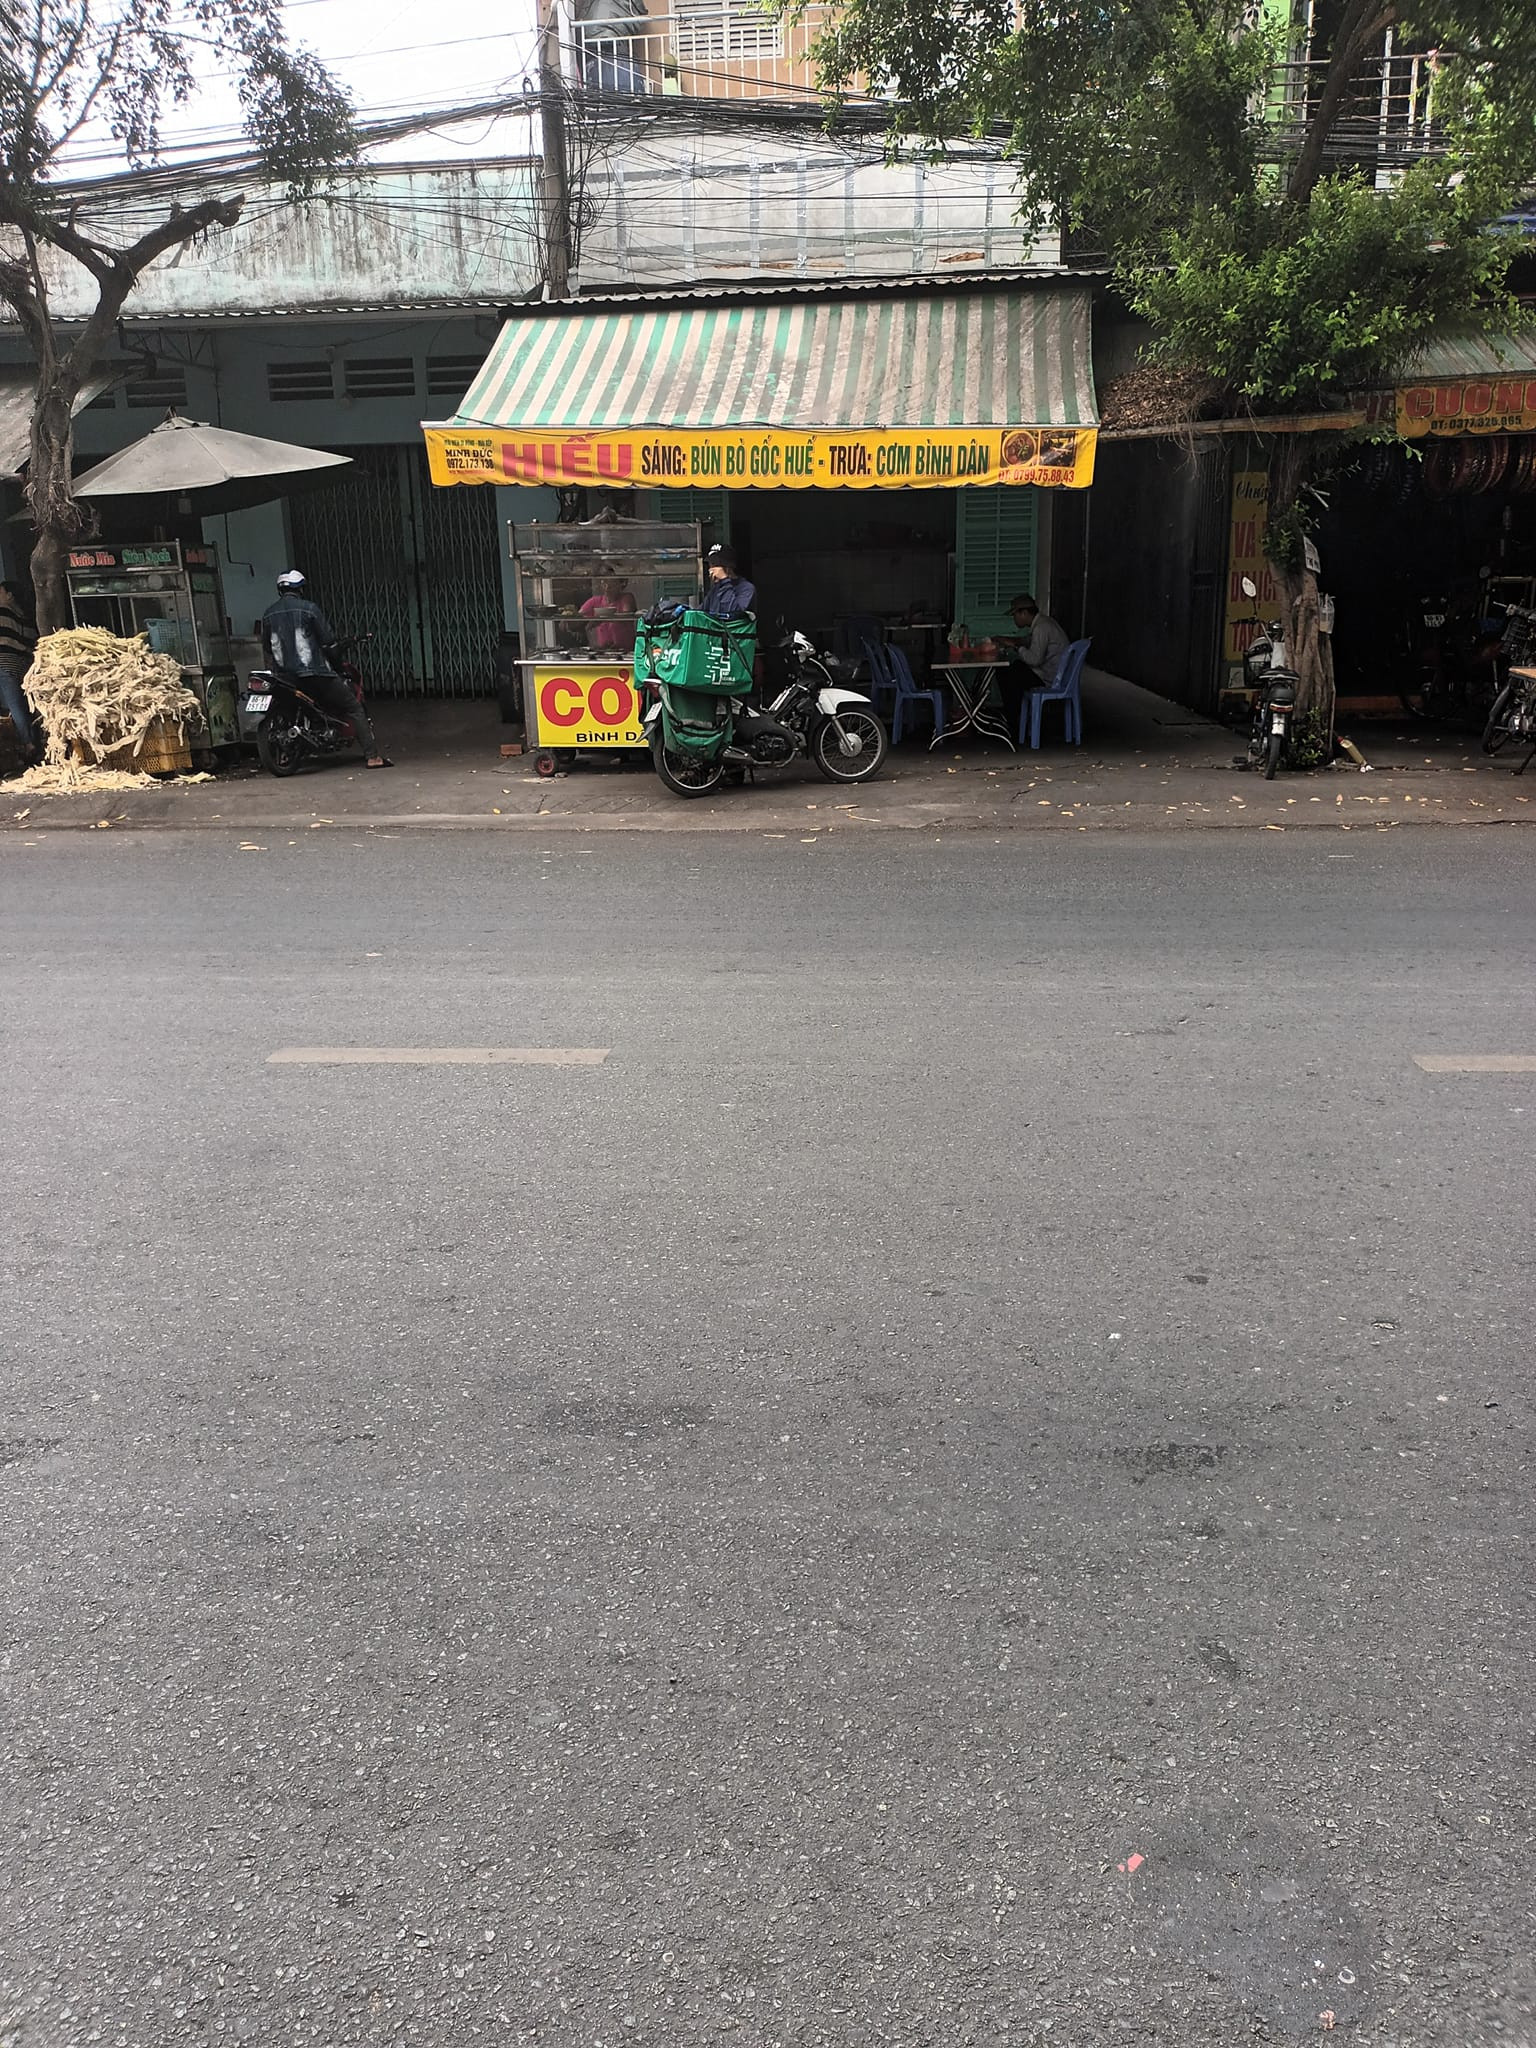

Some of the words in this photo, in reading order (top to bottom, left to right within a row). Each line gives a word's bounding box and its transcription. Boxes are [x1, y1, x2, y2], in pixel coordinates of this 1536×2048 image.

[445, 448, 471, 458] MINH
[472, 446, 493, 458] ĐỨC
[501, 433, 632, 478] HIẾU
[641, 438, 686, 476] SÁNG:
[690, 438, 721, 476] BÚN
[725, 437, 745, 476] BÒ
[750, 434, 781, 476] GỐC
[784, 434, 817, 476] HUẾ
[828, 441, 872, 476] TRƯA:
[876, 441, 911, 476] CƠM
[914, 438, 953, 476] BÌNH
[956, 438, 990, 476] DÂN
[1013, 468, 1075, 482] 0799.75.88.43
[1235, 480, 1269, 506] Chuy
[1235, 513, 1256, 558] VÁ
[540, 668, 642, 727] CƠ
[576, 730, 619, 743] BÌNH
